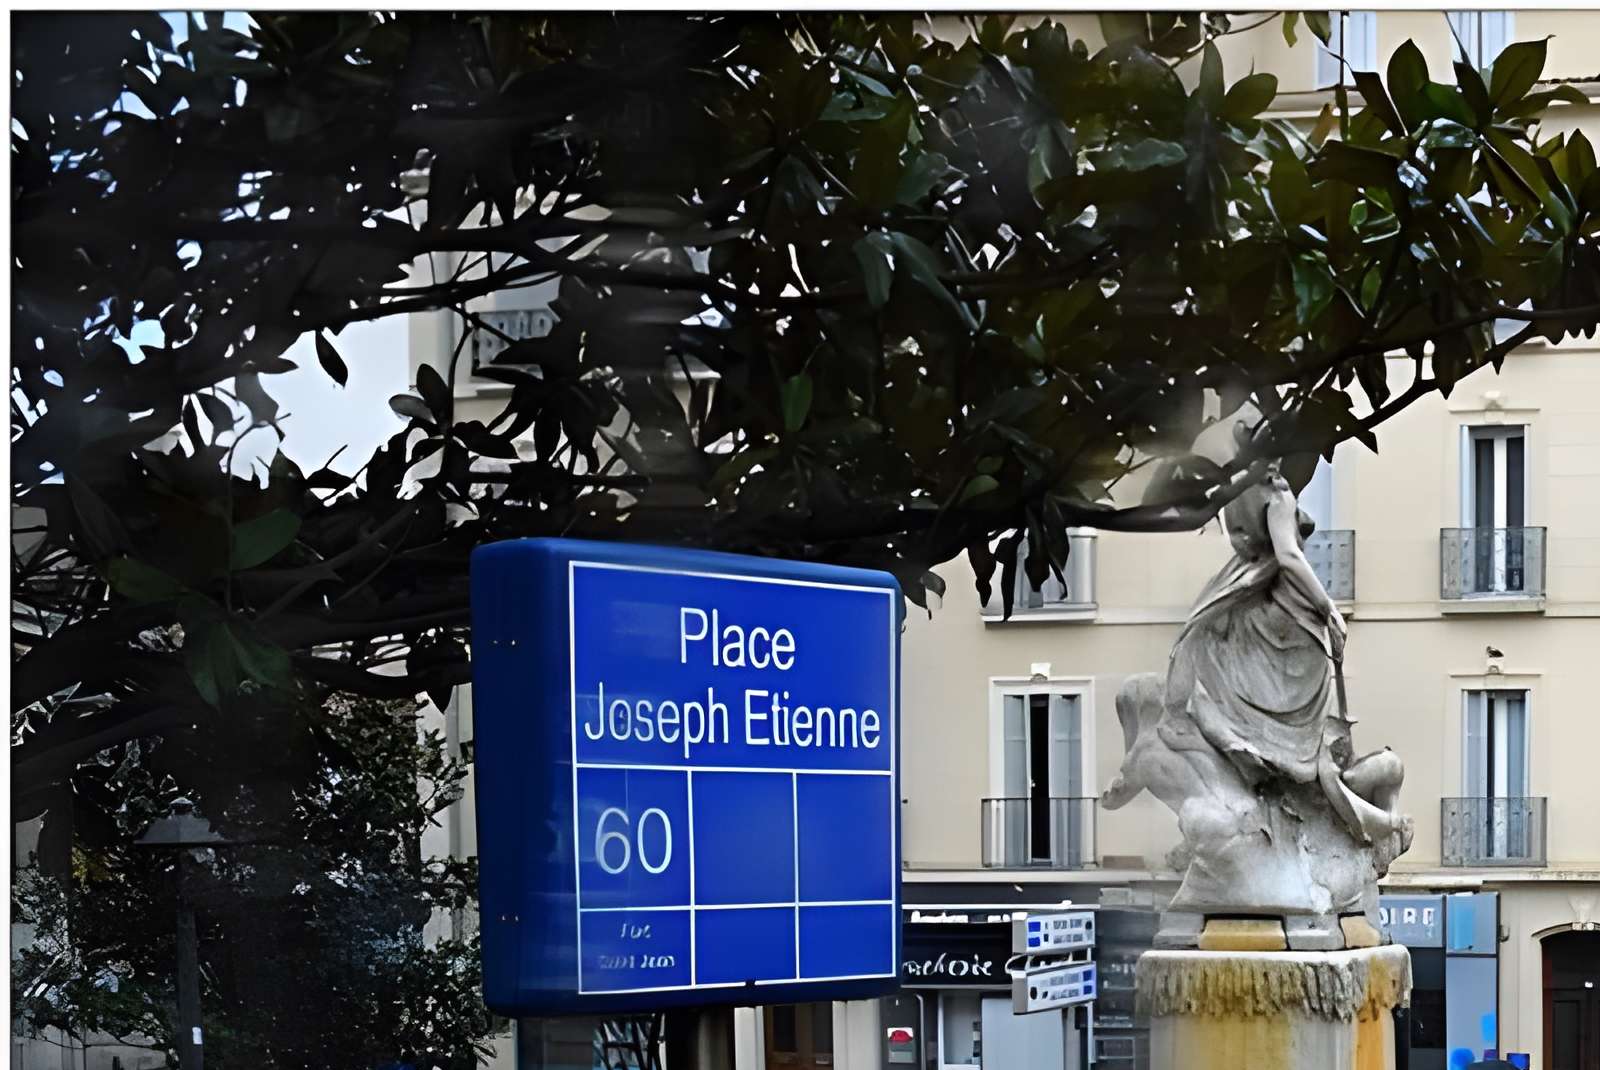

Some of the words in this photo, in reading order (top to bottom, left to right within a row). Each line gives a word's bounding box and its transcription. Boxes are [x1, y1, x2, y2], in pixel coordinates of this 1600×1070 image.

[680, 607, 796, 671] Place
[584, 682, 730, 759] Joseph
[744, 688, 881, 749] Etienne
[594, 806, 673, 875] 60
